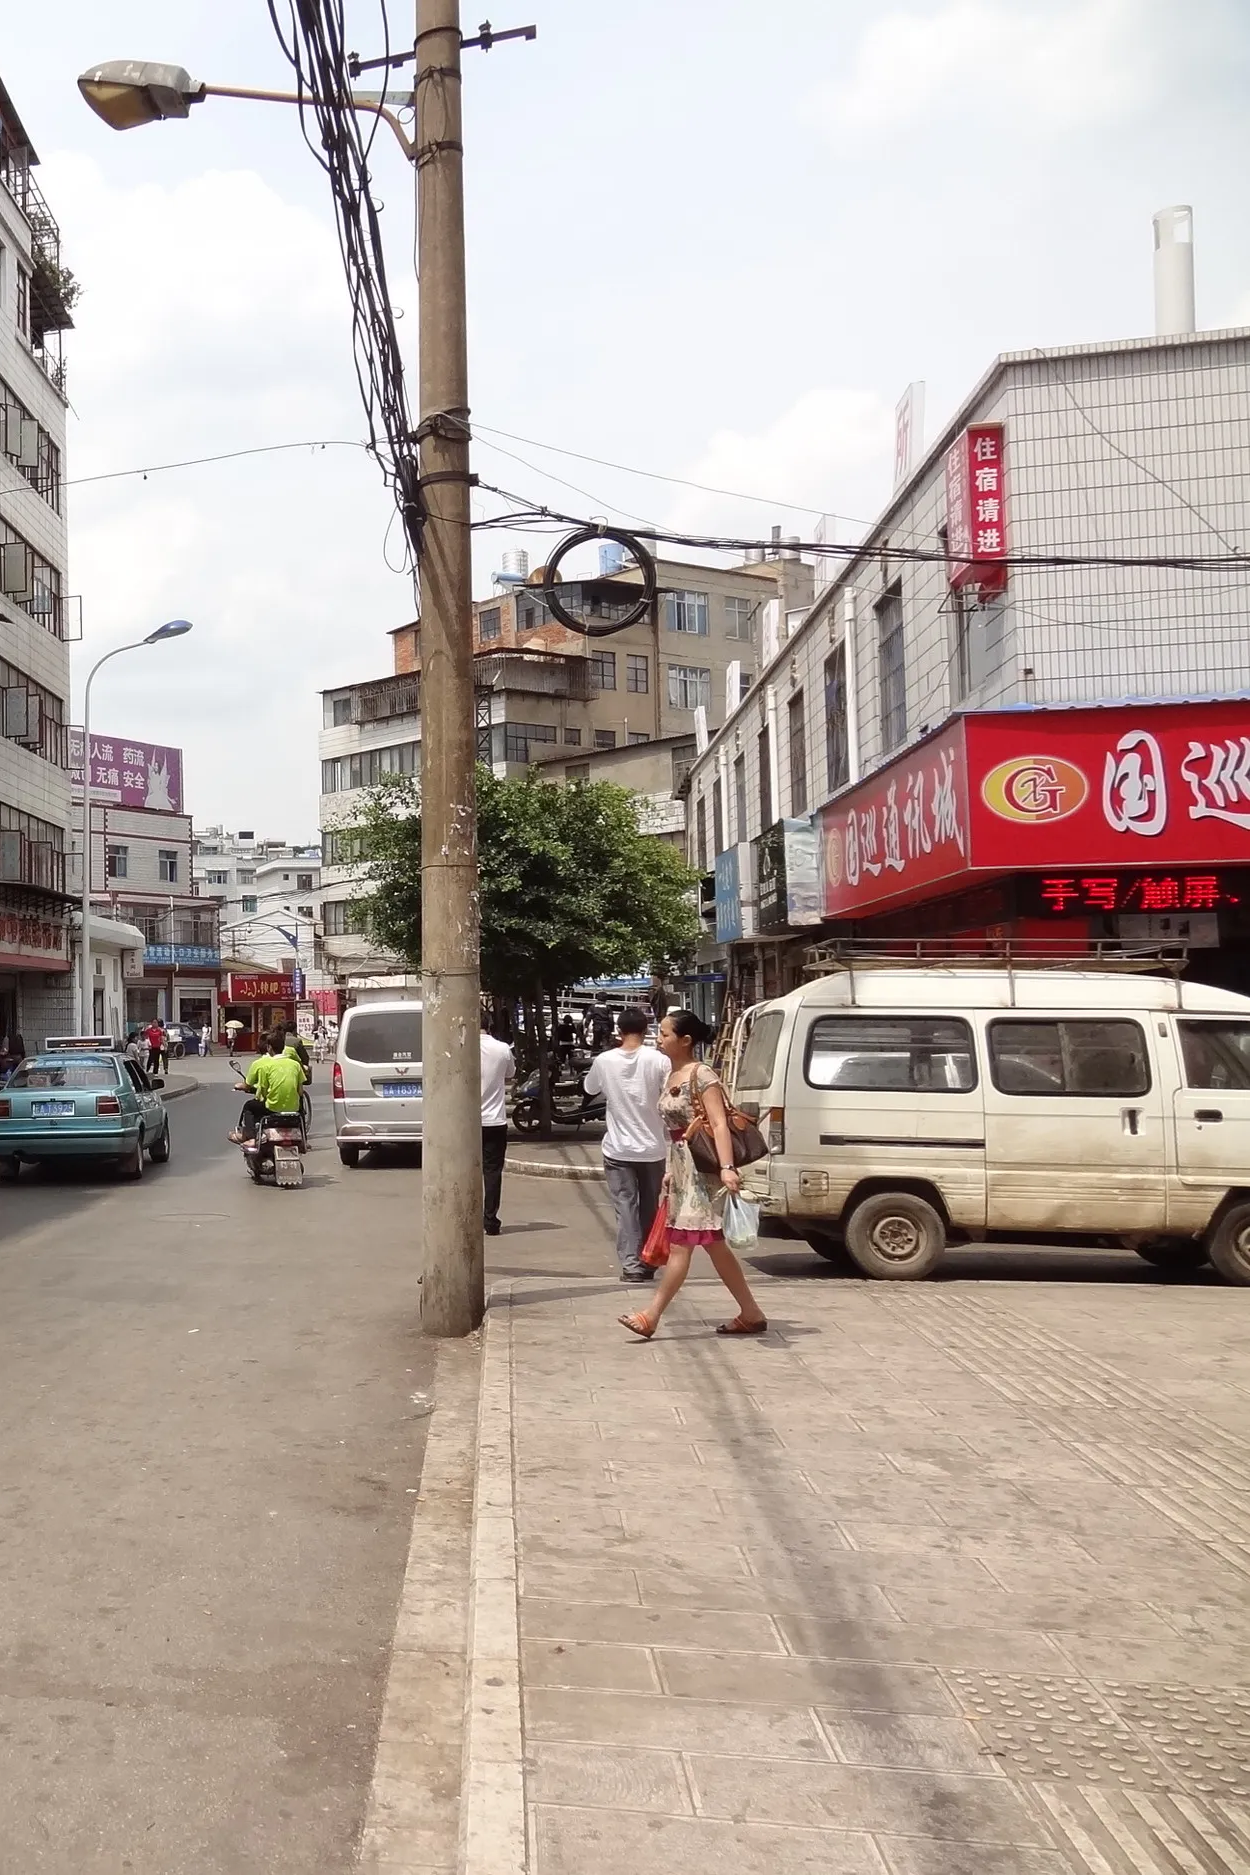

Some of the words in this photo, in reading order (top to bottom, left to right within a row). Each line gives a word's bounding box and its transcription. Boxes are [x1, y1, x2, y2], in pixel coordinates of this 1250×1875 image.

[948, 448, 966, 554] 住宿请进
[974, 437, 1001, 553] 住宿请进
[96, 767, 119, 786] 无痛
[123, 771, 145, 789] 安全
[123, 747, 145, 767] 药流
